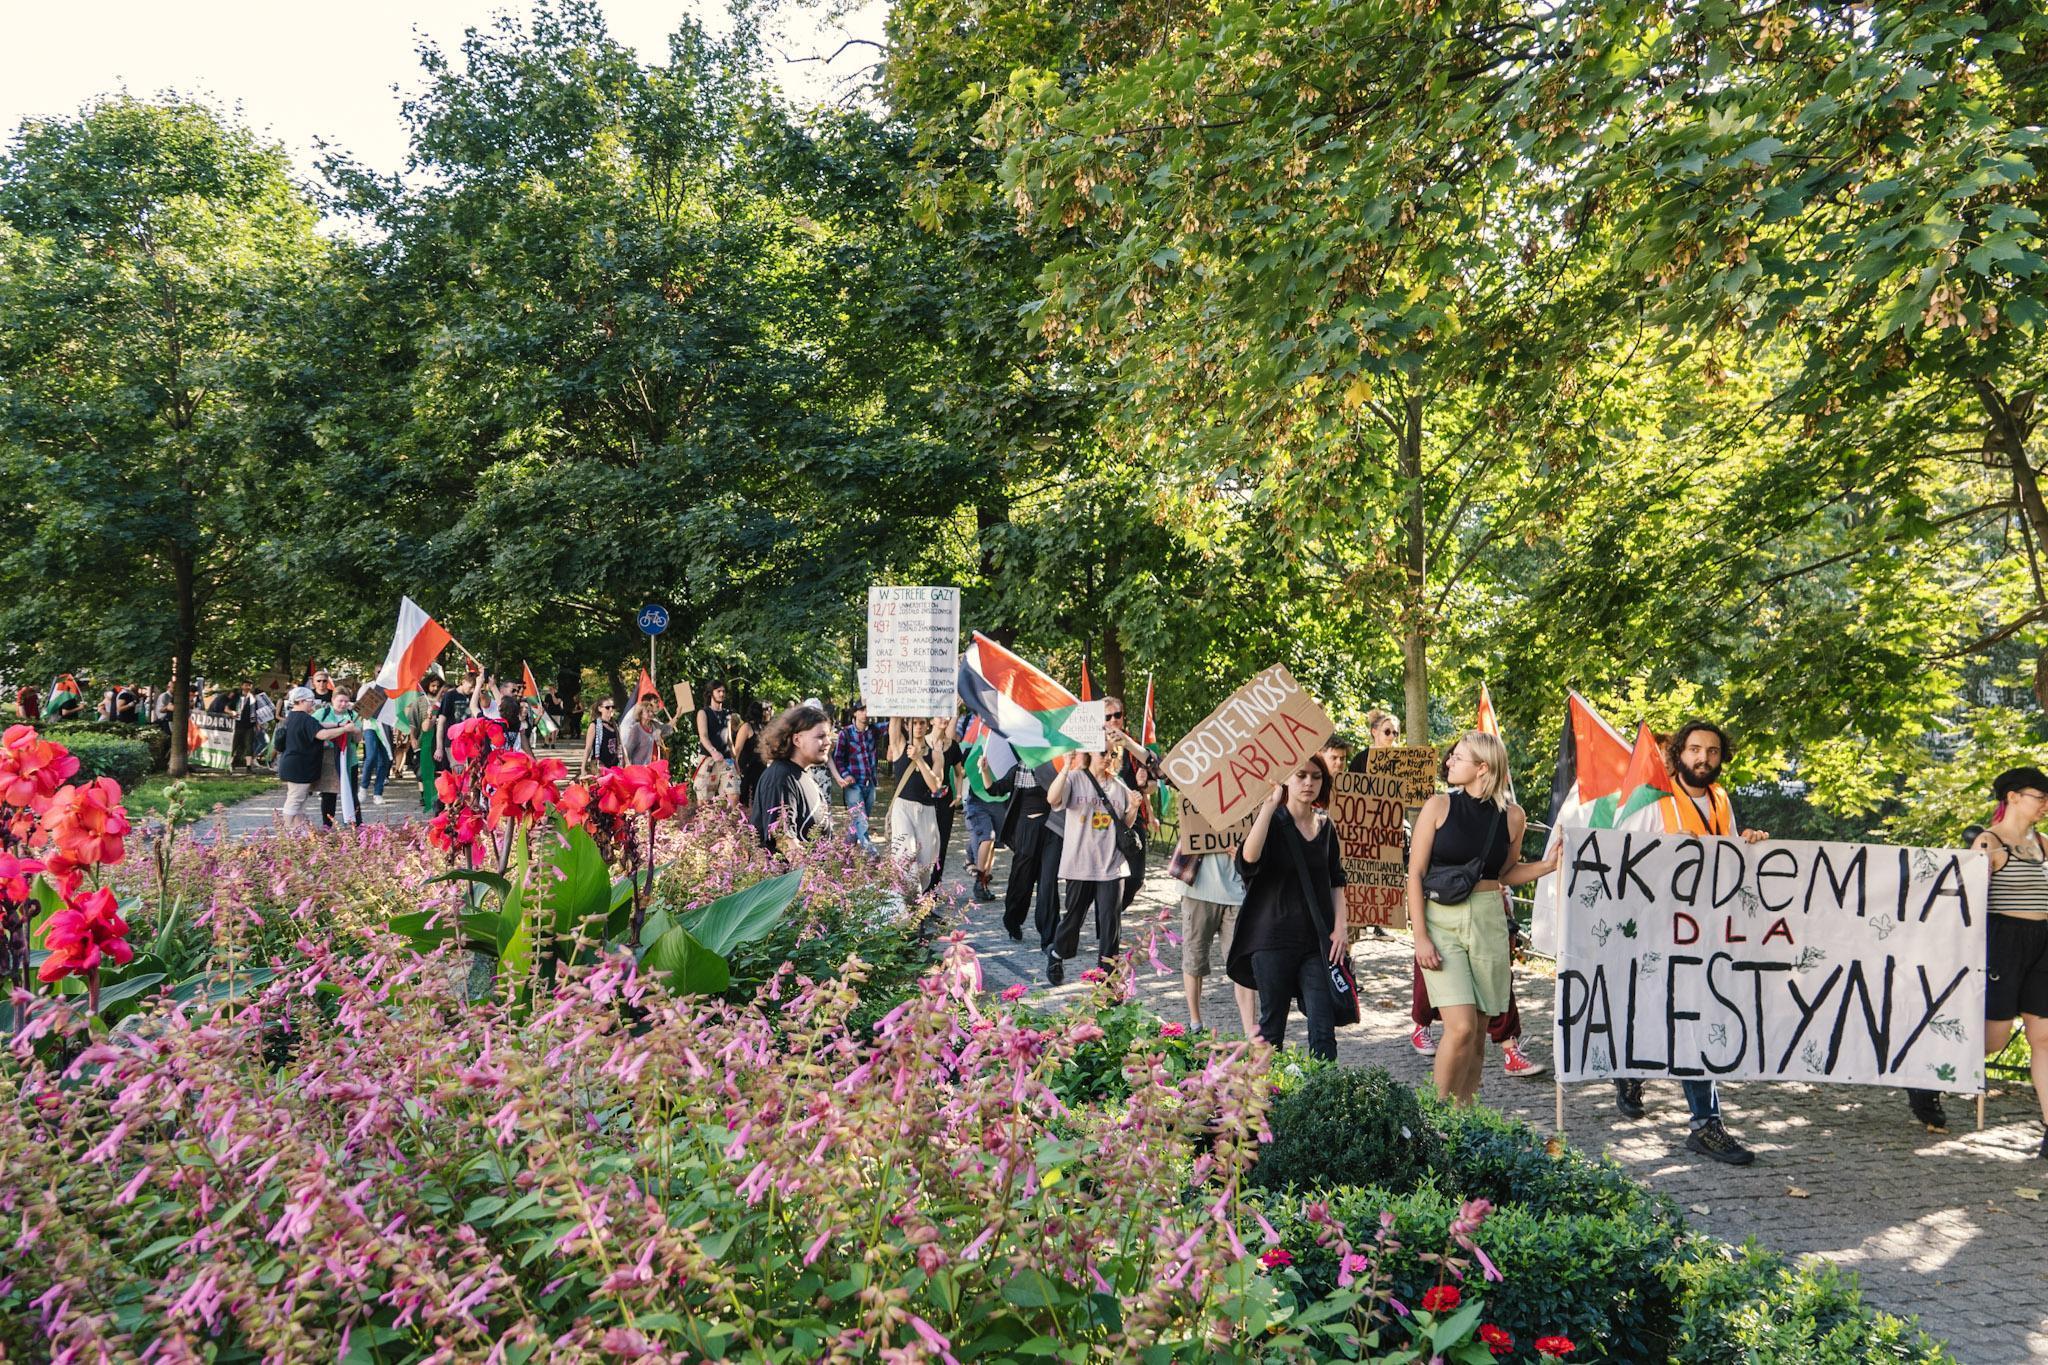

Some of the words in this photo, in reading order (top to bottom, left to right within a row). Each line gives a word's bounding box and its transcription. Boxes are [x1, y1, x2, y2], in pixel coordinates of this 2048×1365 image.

[879, 589, 889, 600] W
[893, 588, 925, 600] STREFIE
[931, 588, 954, 601] GAZY
[873, 602, 896, 616] 12/12
[874, 620, 890, 633] 497
[876, 649, 893, 657] ORAZ
[901, 647, 908, 657] 3
[873, 659, 891, 674] 357
[870, 678, 894, 695] 9241
[1168, 668, 1298, 784] OBOJĘTNOŚĆ
[1202, 712, 1319, 814] ZABIJA
[1335, 772, 1352, 793] CO
[1353, 774, 1386, 797] ROKU
[1334, 794, 1403, 829] 500-700
[1190, 832, 1243, 851] EDUK
[1344, 842, 1380, 860] DZIECI
[1346, 870, 1379, 885] ZONYCH
[1381, 873, 1405, 888] PRZEZ
[1673, 912, 1794, 945] DLA
[1558, 951, 1970, 1075] PALESTYNY
